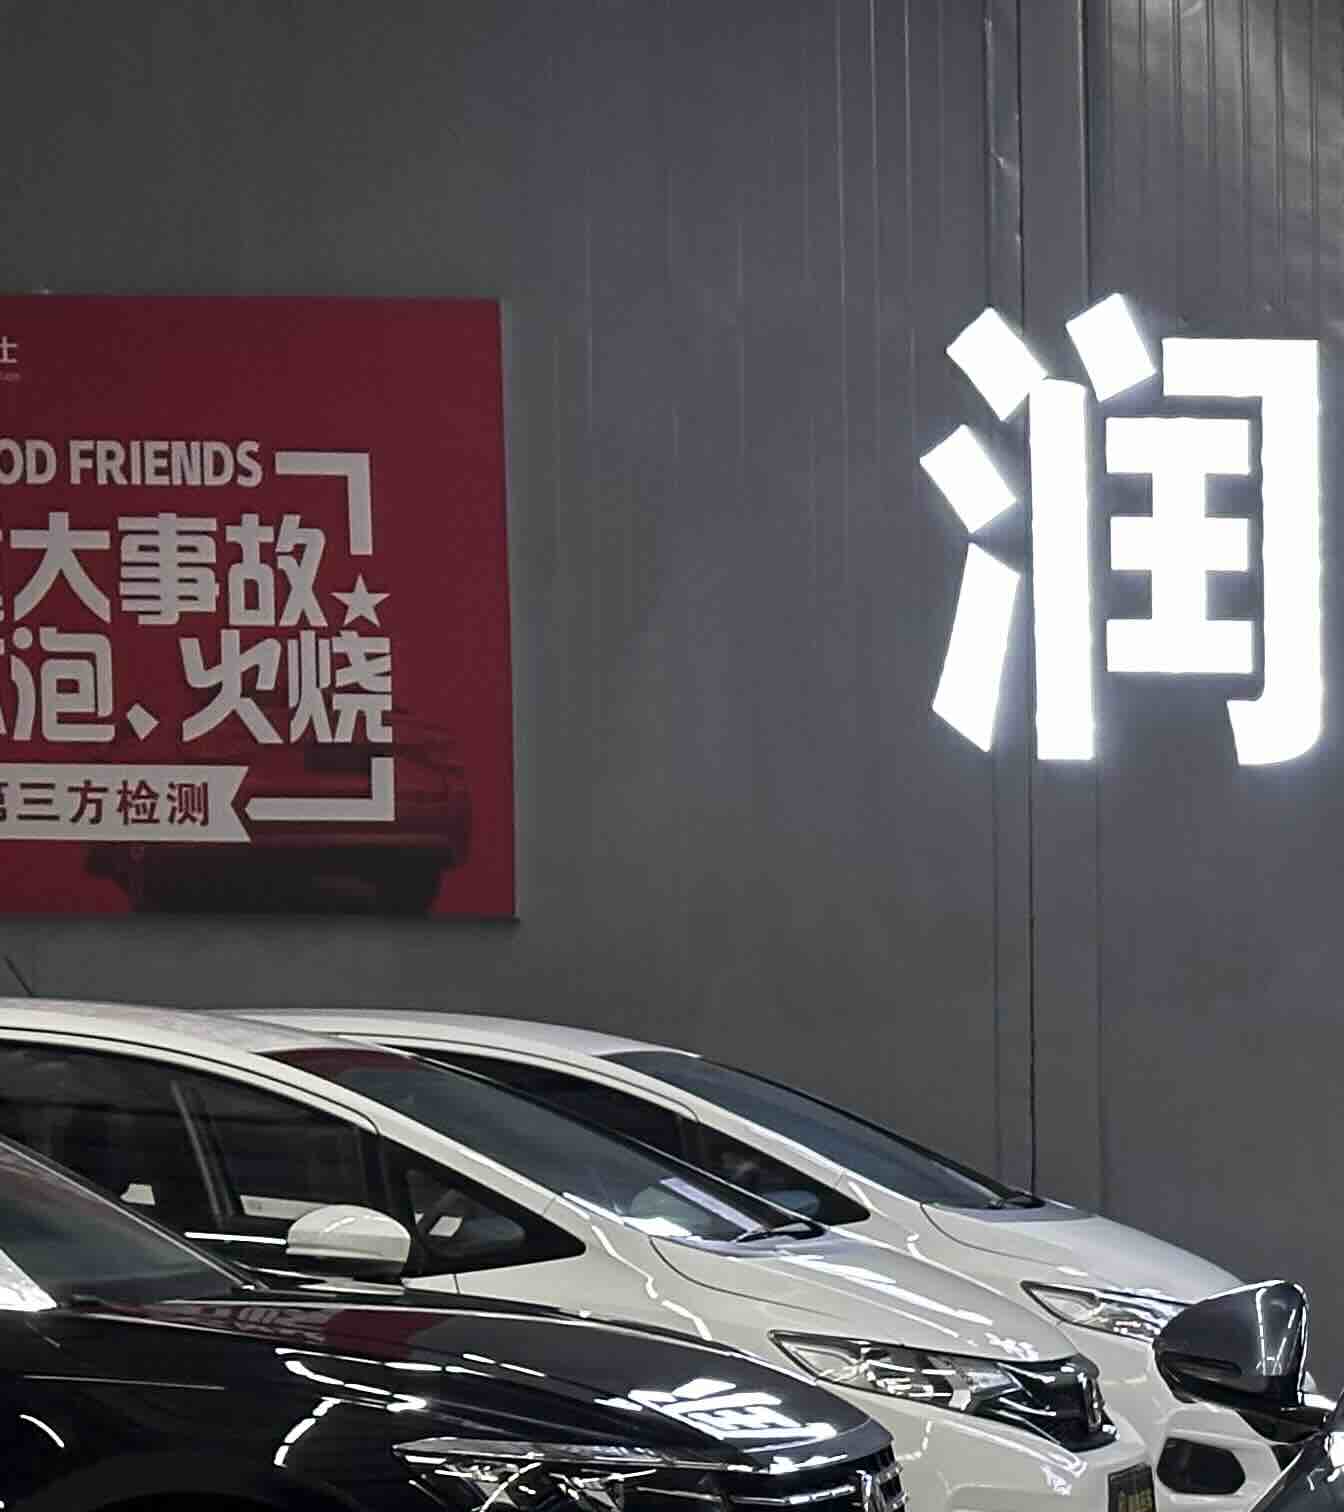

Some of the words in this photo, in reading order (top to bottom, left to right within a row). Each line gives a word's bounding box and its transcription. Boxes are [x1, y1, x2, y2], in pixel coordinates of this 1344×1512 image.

[69, 439, 263, 487] FRIENDS
[0, 511, 328, 627] 大事故
[0, 621, 393, 744] 泡、火烧
[0, 780, 209, 826] 三方检测
